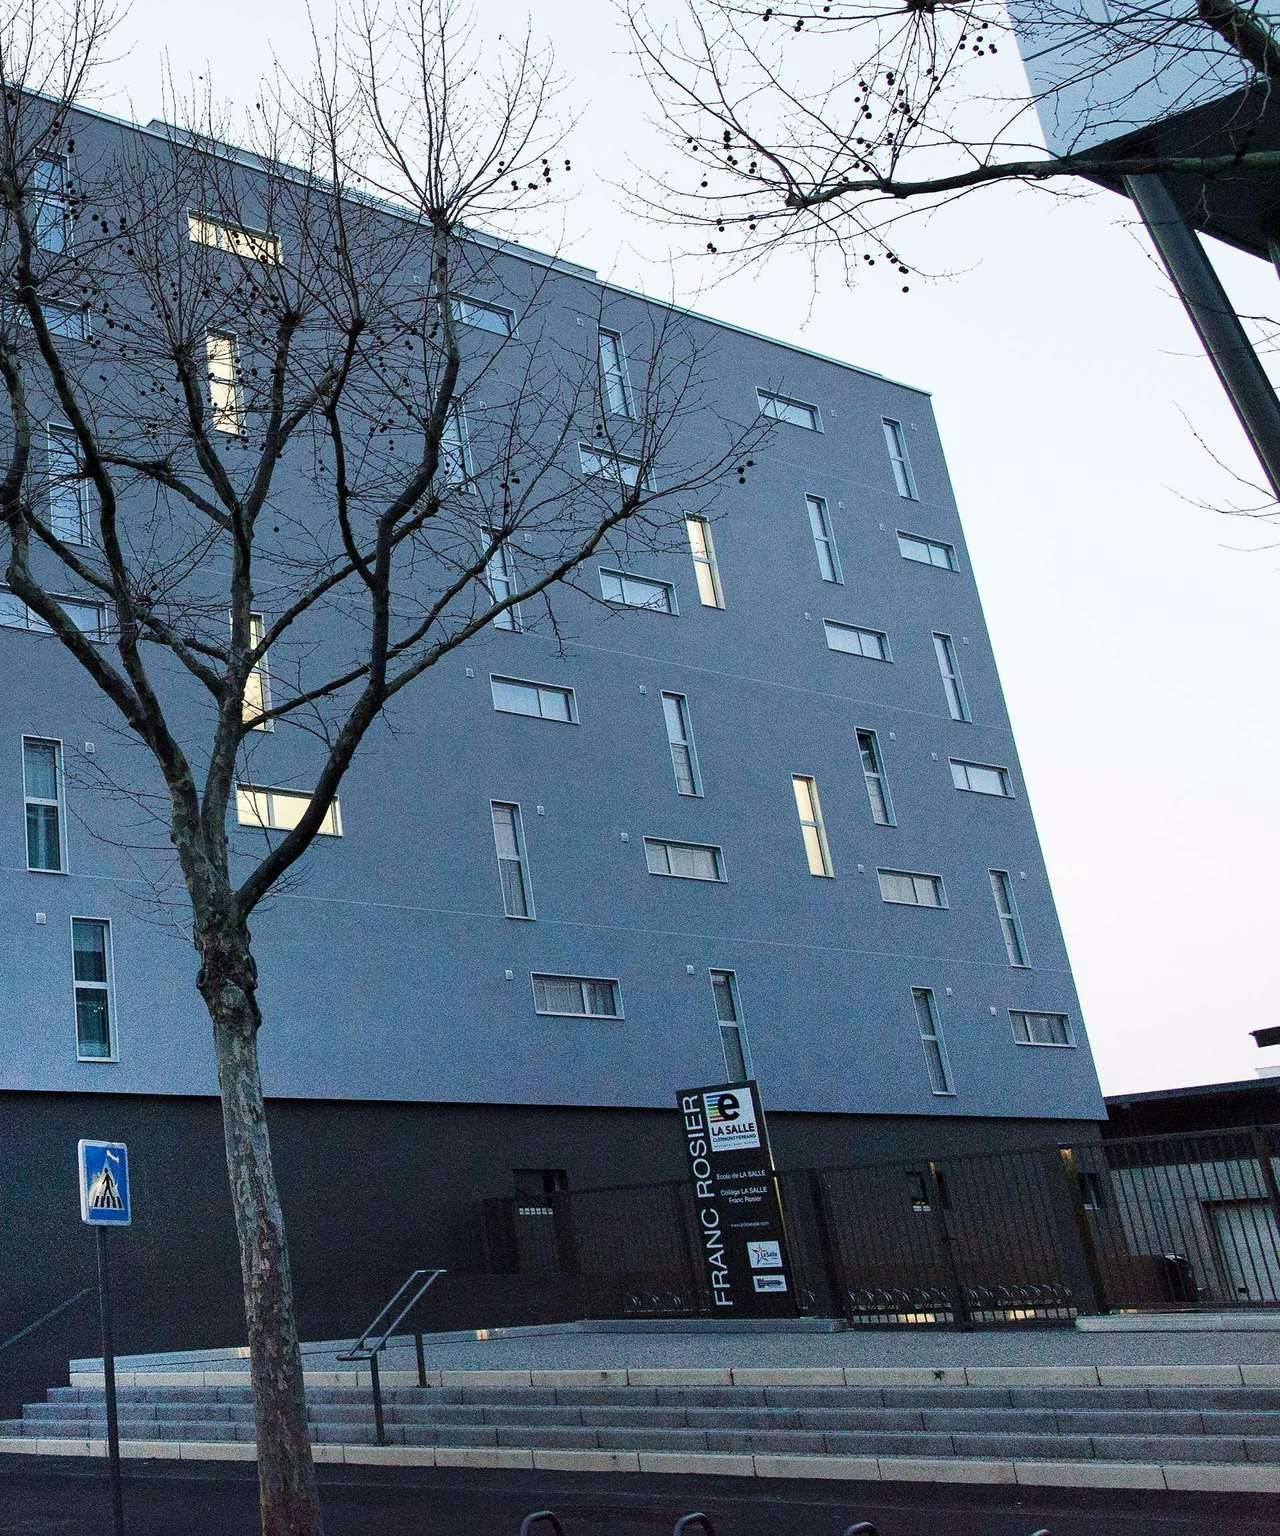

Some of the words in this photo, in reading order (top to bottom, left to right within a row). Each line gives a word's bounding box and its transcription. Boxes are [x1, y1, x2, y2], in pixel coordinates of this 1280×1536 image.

[711, 1125, 724, 1136] LA
[725, 1122, 755, 1135] SALLE
[683, 1095, 714, 1198] ROSIER
[747, 1169, 766, 1178] SALLE
[749, 1186, 768, 1194] SALLE
[700, 1207, 734, 1306] FRANC
